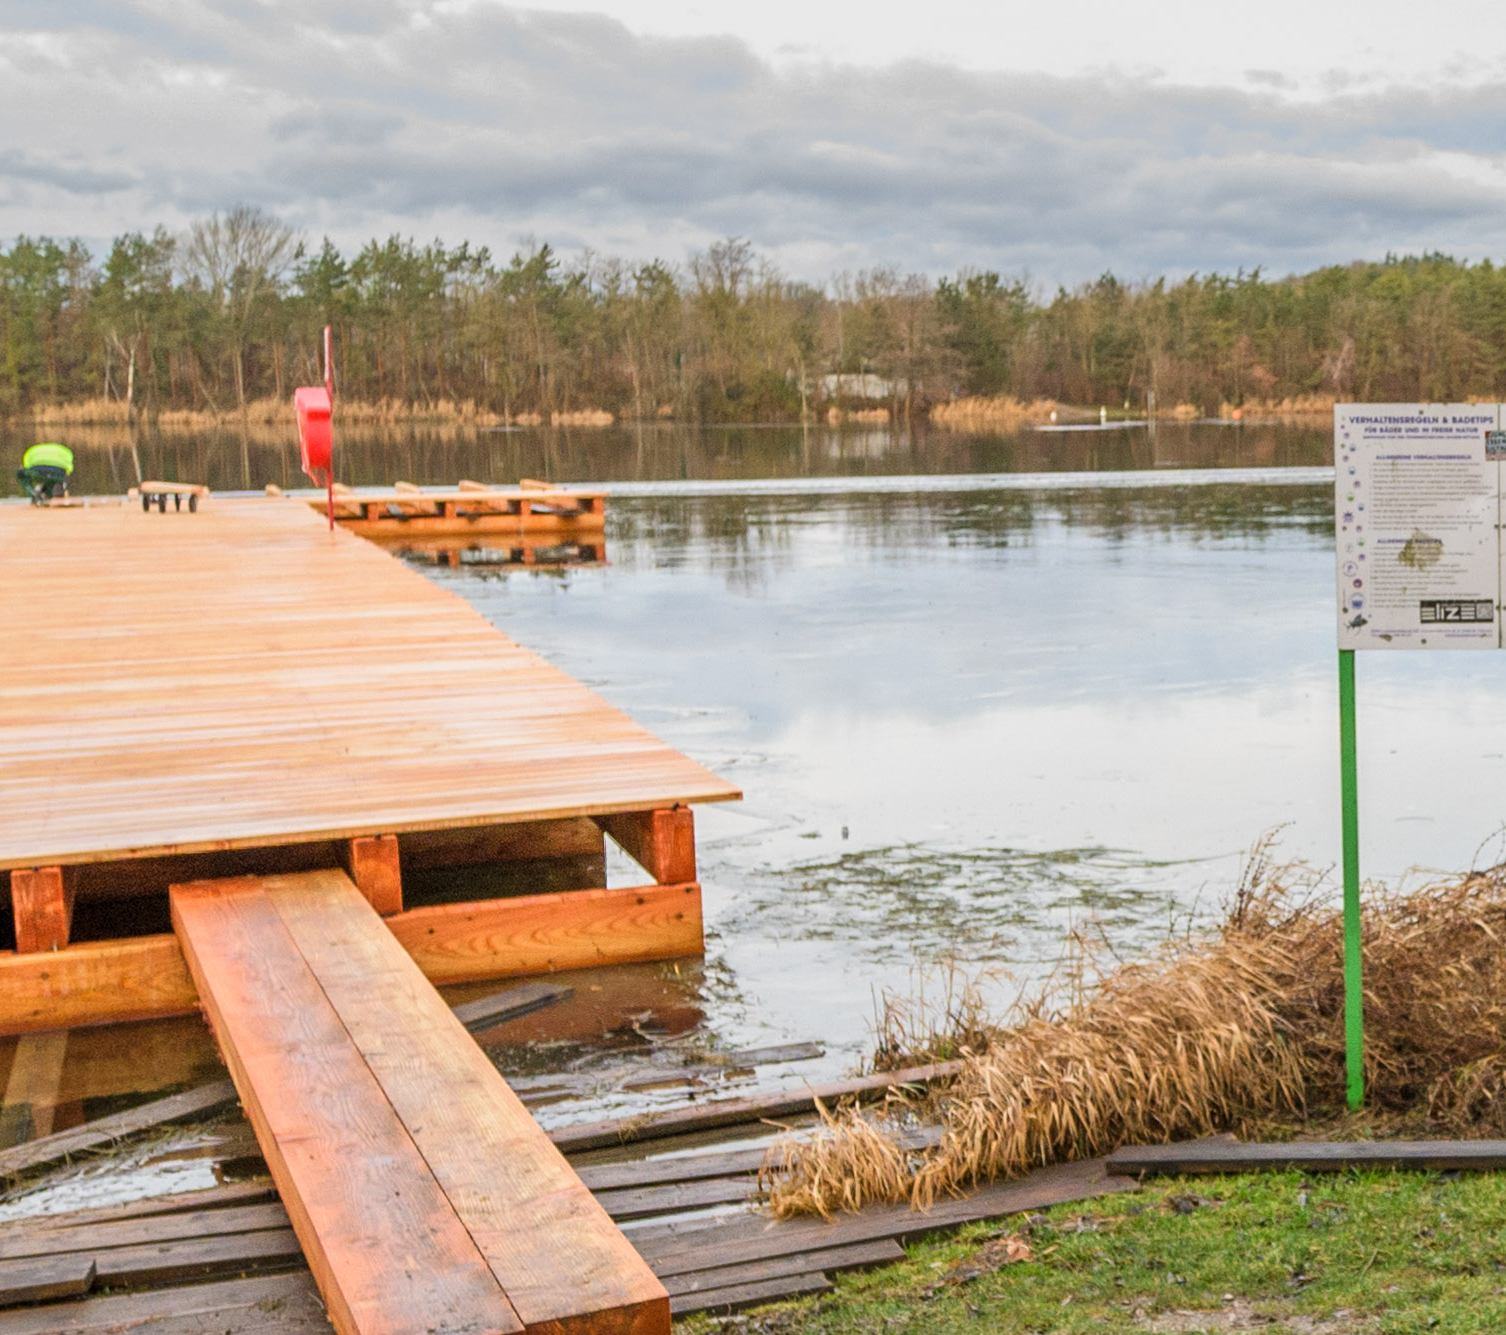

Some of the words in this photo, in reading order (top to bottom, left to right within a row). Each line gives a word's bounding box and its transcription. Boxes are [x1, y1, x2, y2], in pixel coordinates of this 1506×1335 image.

[1349, 416, 1439, 424] VERHALTENSREGELN
[1442, 416, 1448, 424] &
[1452, 416, 1494, 424] BADETIPS
